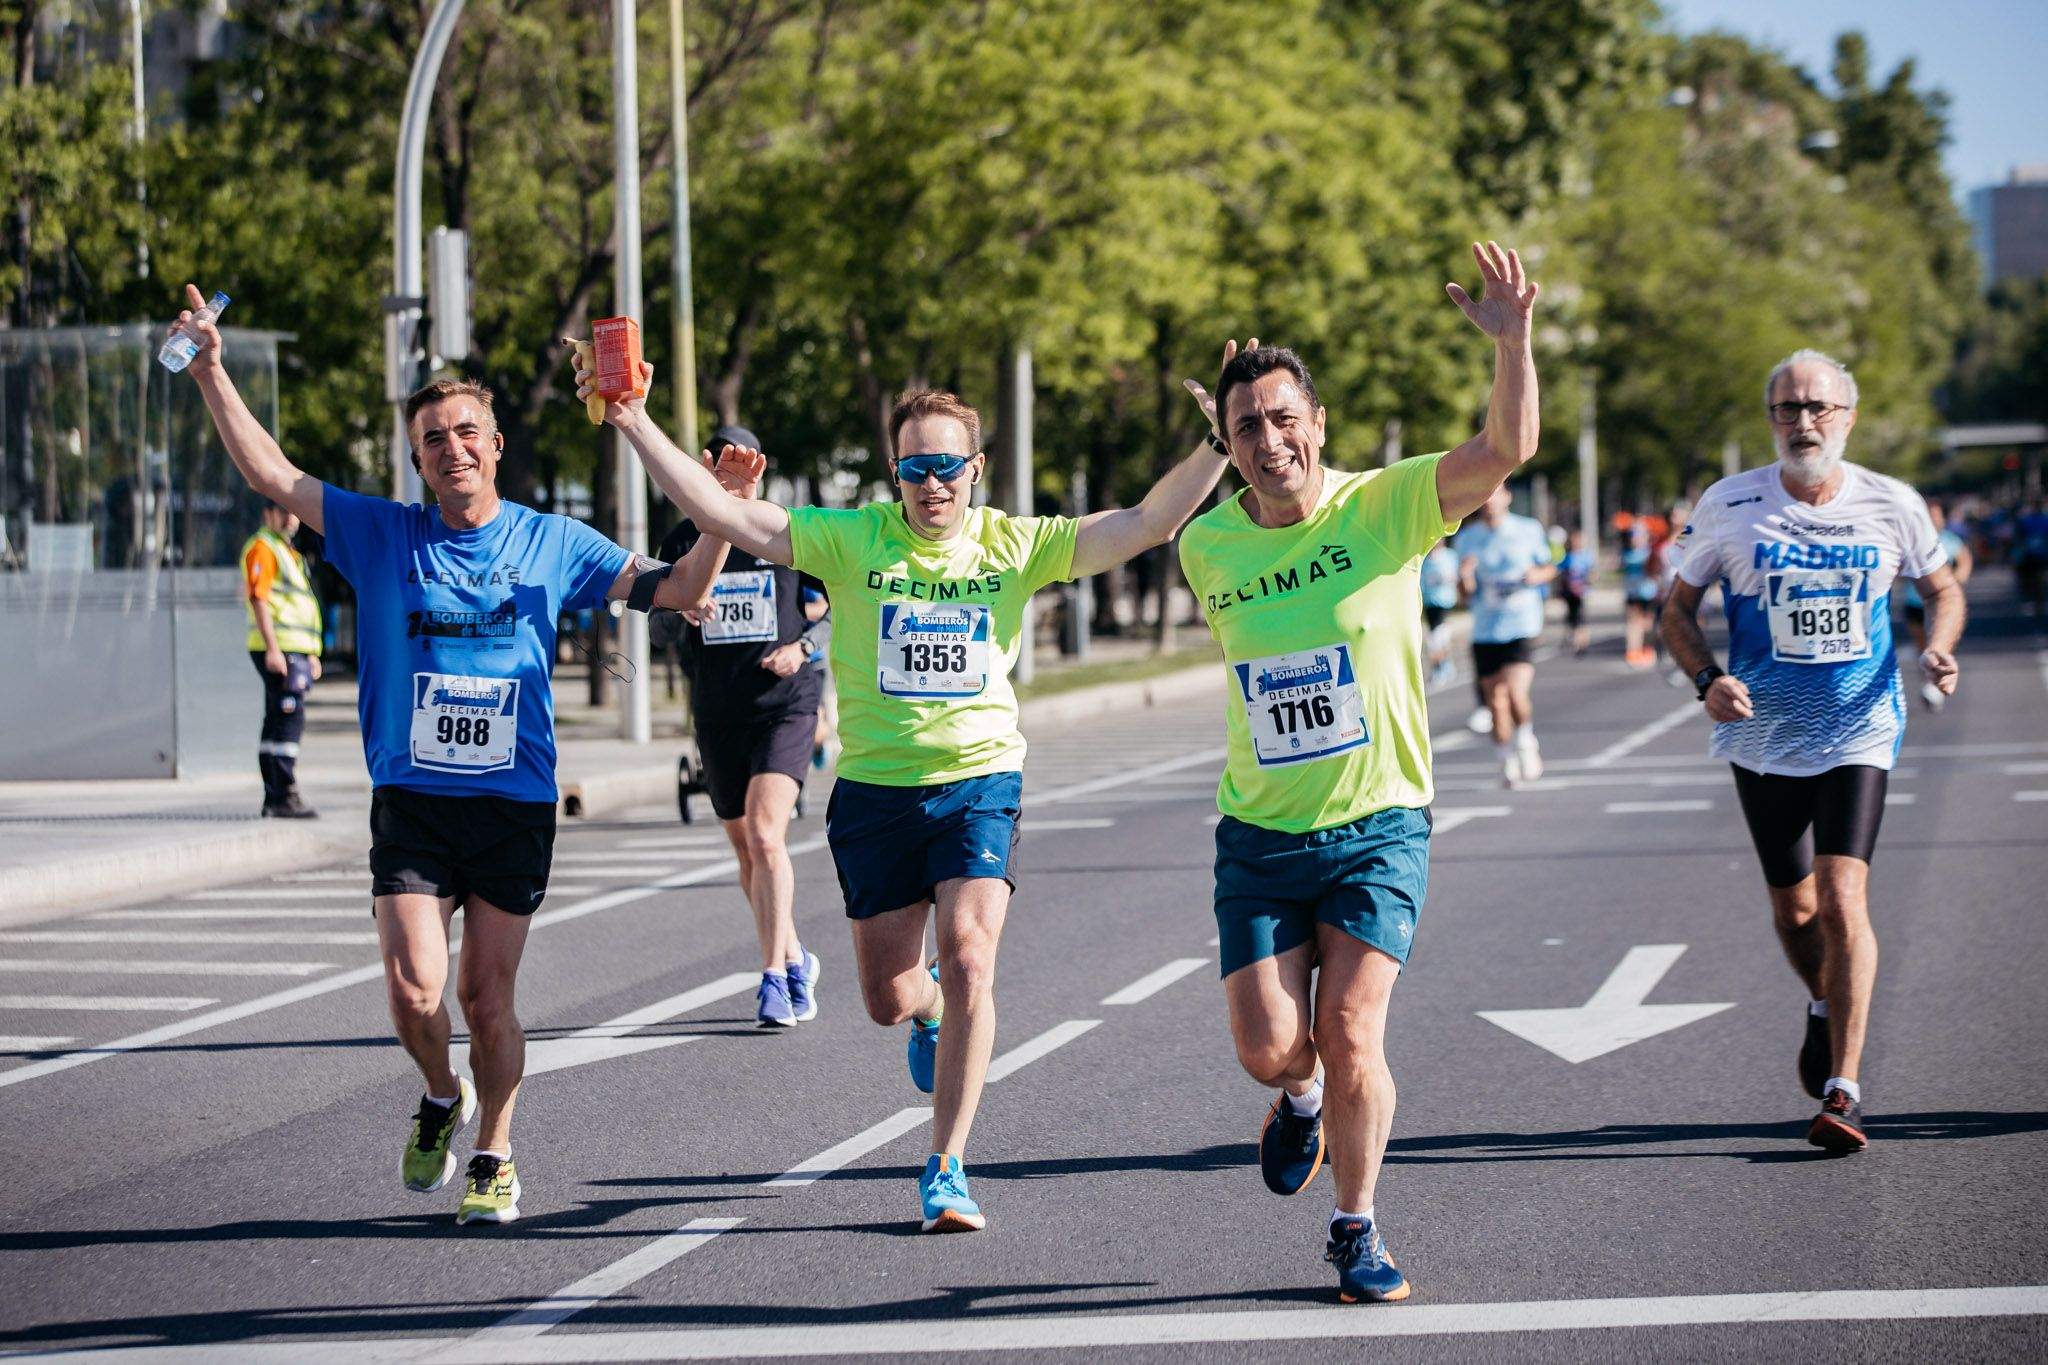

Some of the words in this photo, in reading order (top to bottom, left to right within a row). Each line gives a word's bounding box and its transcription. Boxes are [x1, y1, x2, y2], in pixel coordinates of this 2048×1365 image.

[1753, 542, 1880, 570] MADRID
[867, 570, 1002, 600] DECIMAS
[432, 611, 513, 625] BOMBEROS
[718, 602, 754, 622] 736
[917, 617, 969, 625] BOMBEROS
[1788, 608, 1850, 636] 1938
[910, 633, 967, 642] DECIMAS
[1821, 638, 1851, 655] 2579
[900, 643, 968, 674] 1353
[1271, 663, 1329, 681] BOMBEROS
[447, 689, 500, 701] BOMBEROS
[1269, 681, 1332, 701] DECIMAS
[440, 704, 497, 717] DECIMAS
[1267, 694, 1335, 735] 1716
[436, 715, 490, 747] 988
